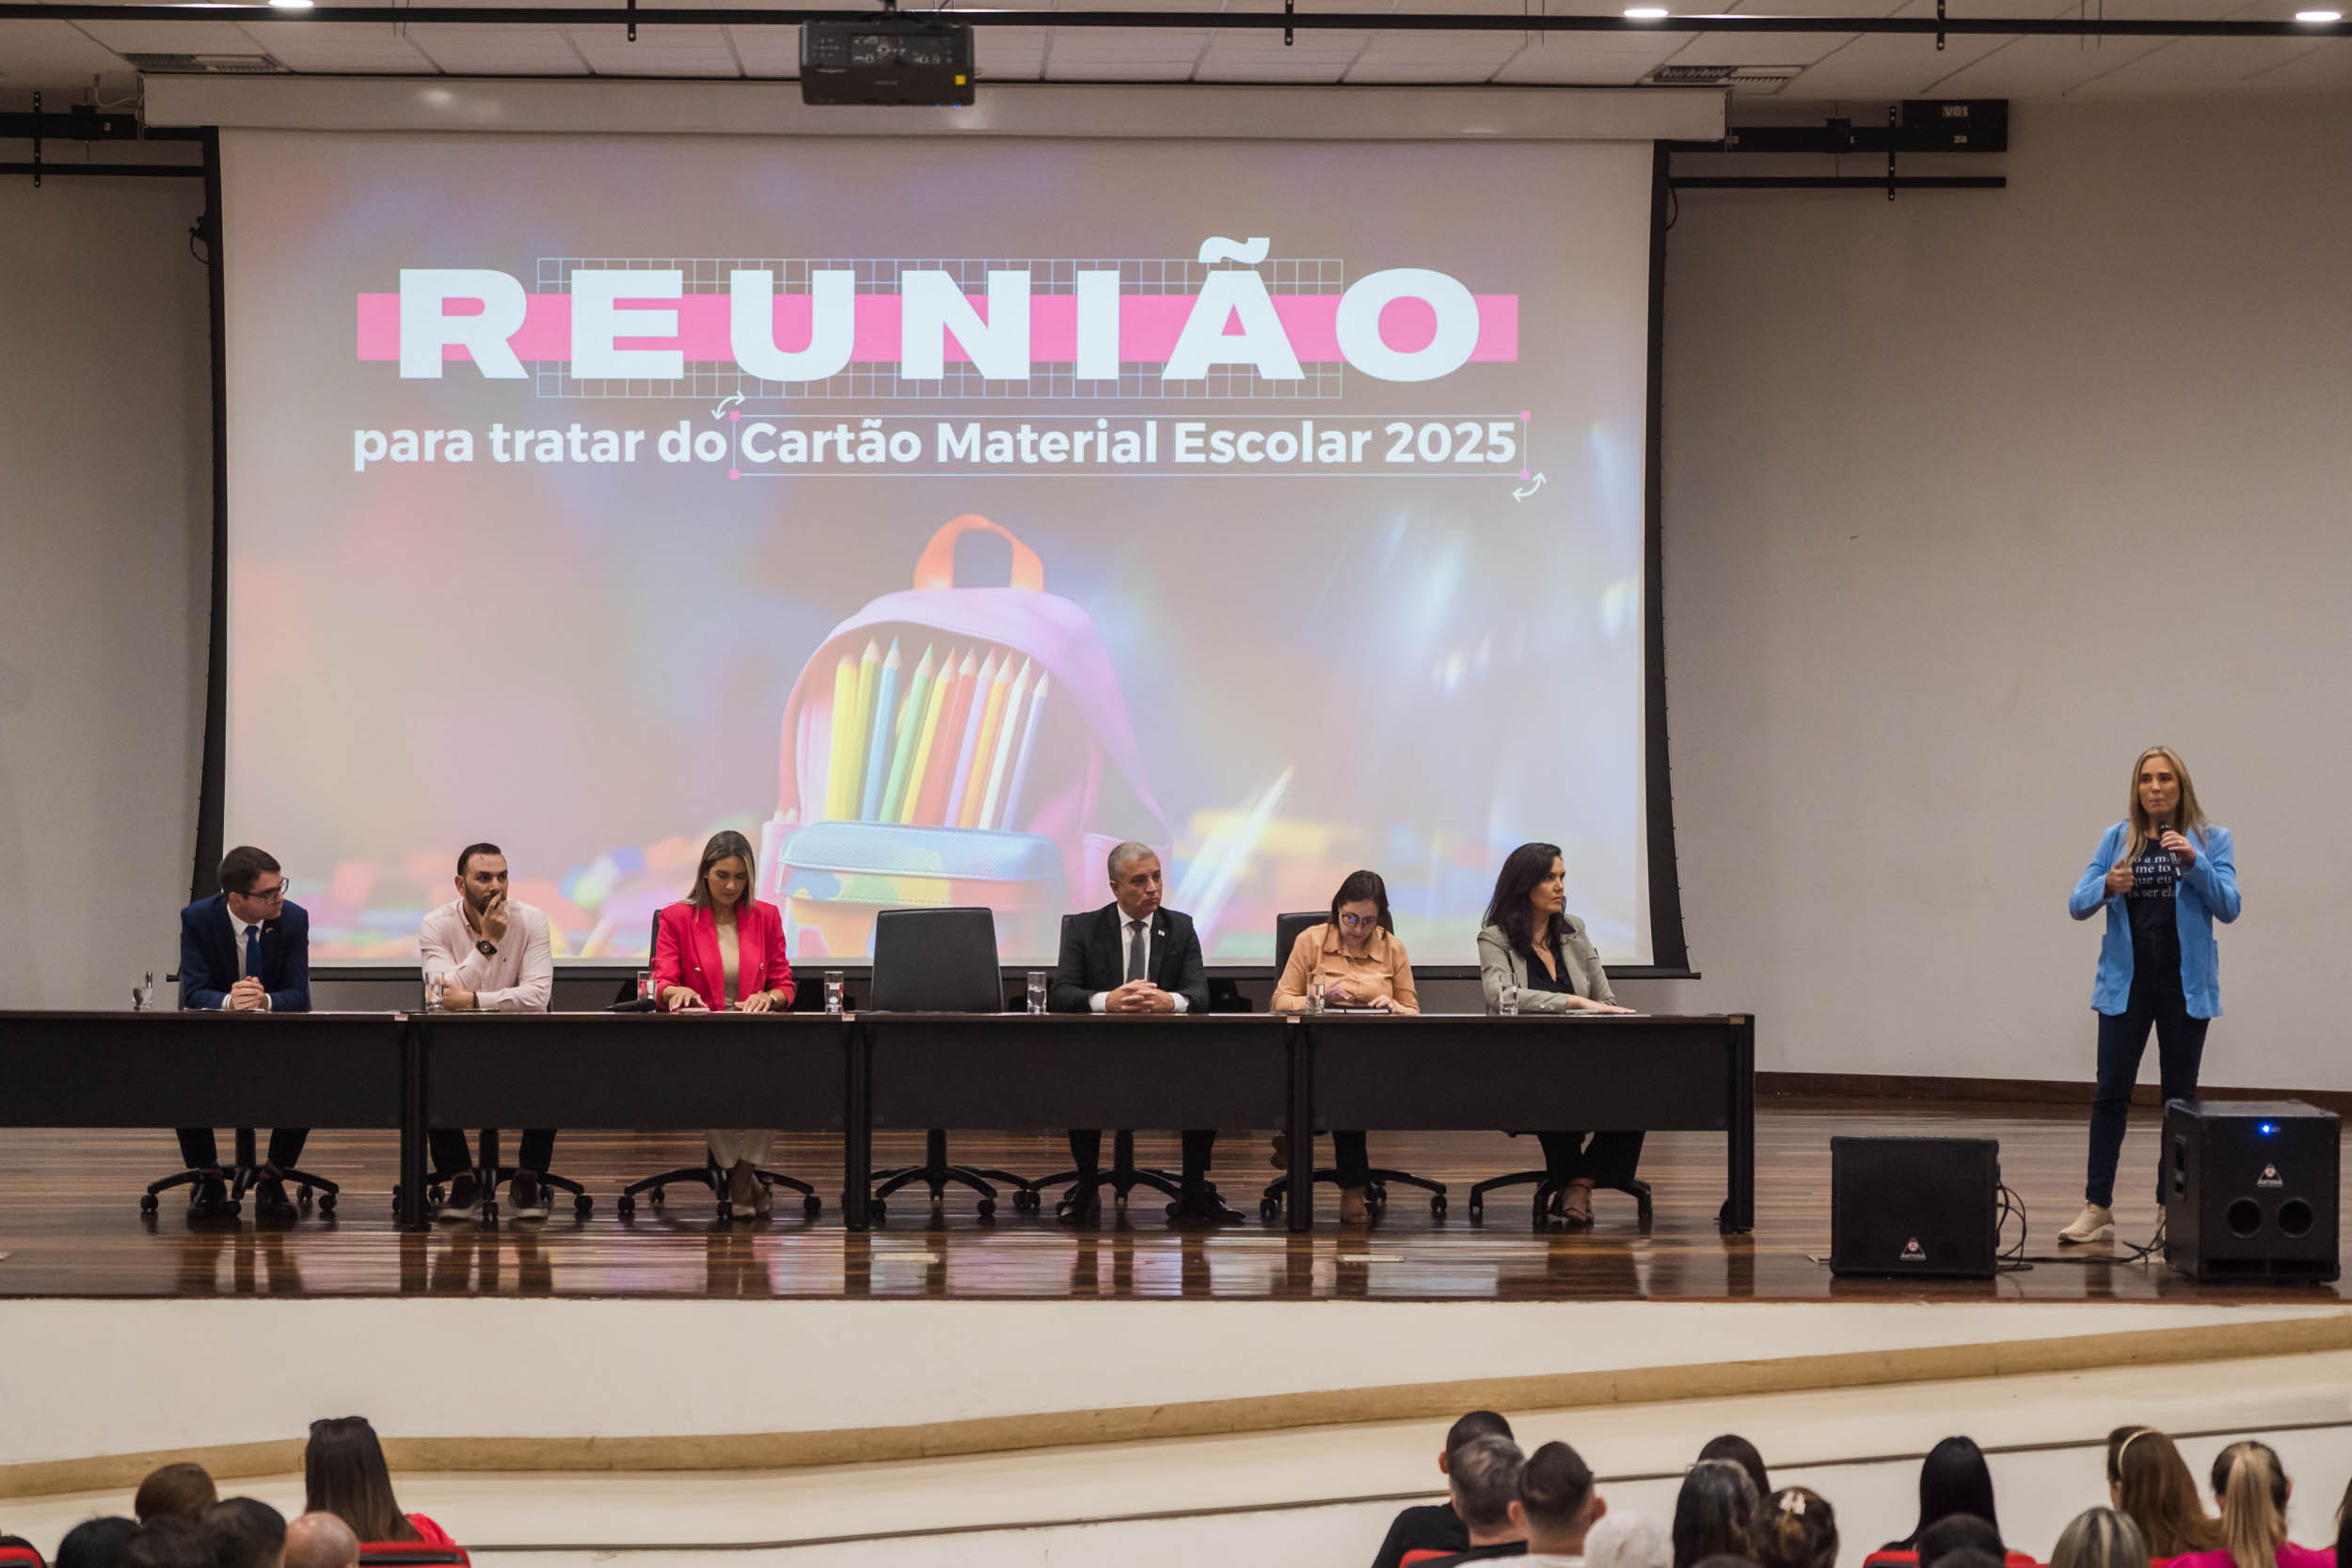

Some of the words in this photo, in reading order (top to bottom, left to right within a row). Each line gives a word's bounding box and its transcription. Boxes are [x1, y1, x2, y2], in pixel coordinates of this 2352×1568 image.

[399, 236, 1480, 384] REUNIÃO
[354, 429, 474, 472] para
[488, 423, 645, 464] tratar
[659, 420, 728, 464] do
[740, 419, 923, 464] Cartão
[937, 419, 1157, 464] Material
[1174, 420, 1374, 464] Escolar
[1384, 421, 1517, 464] 2025
